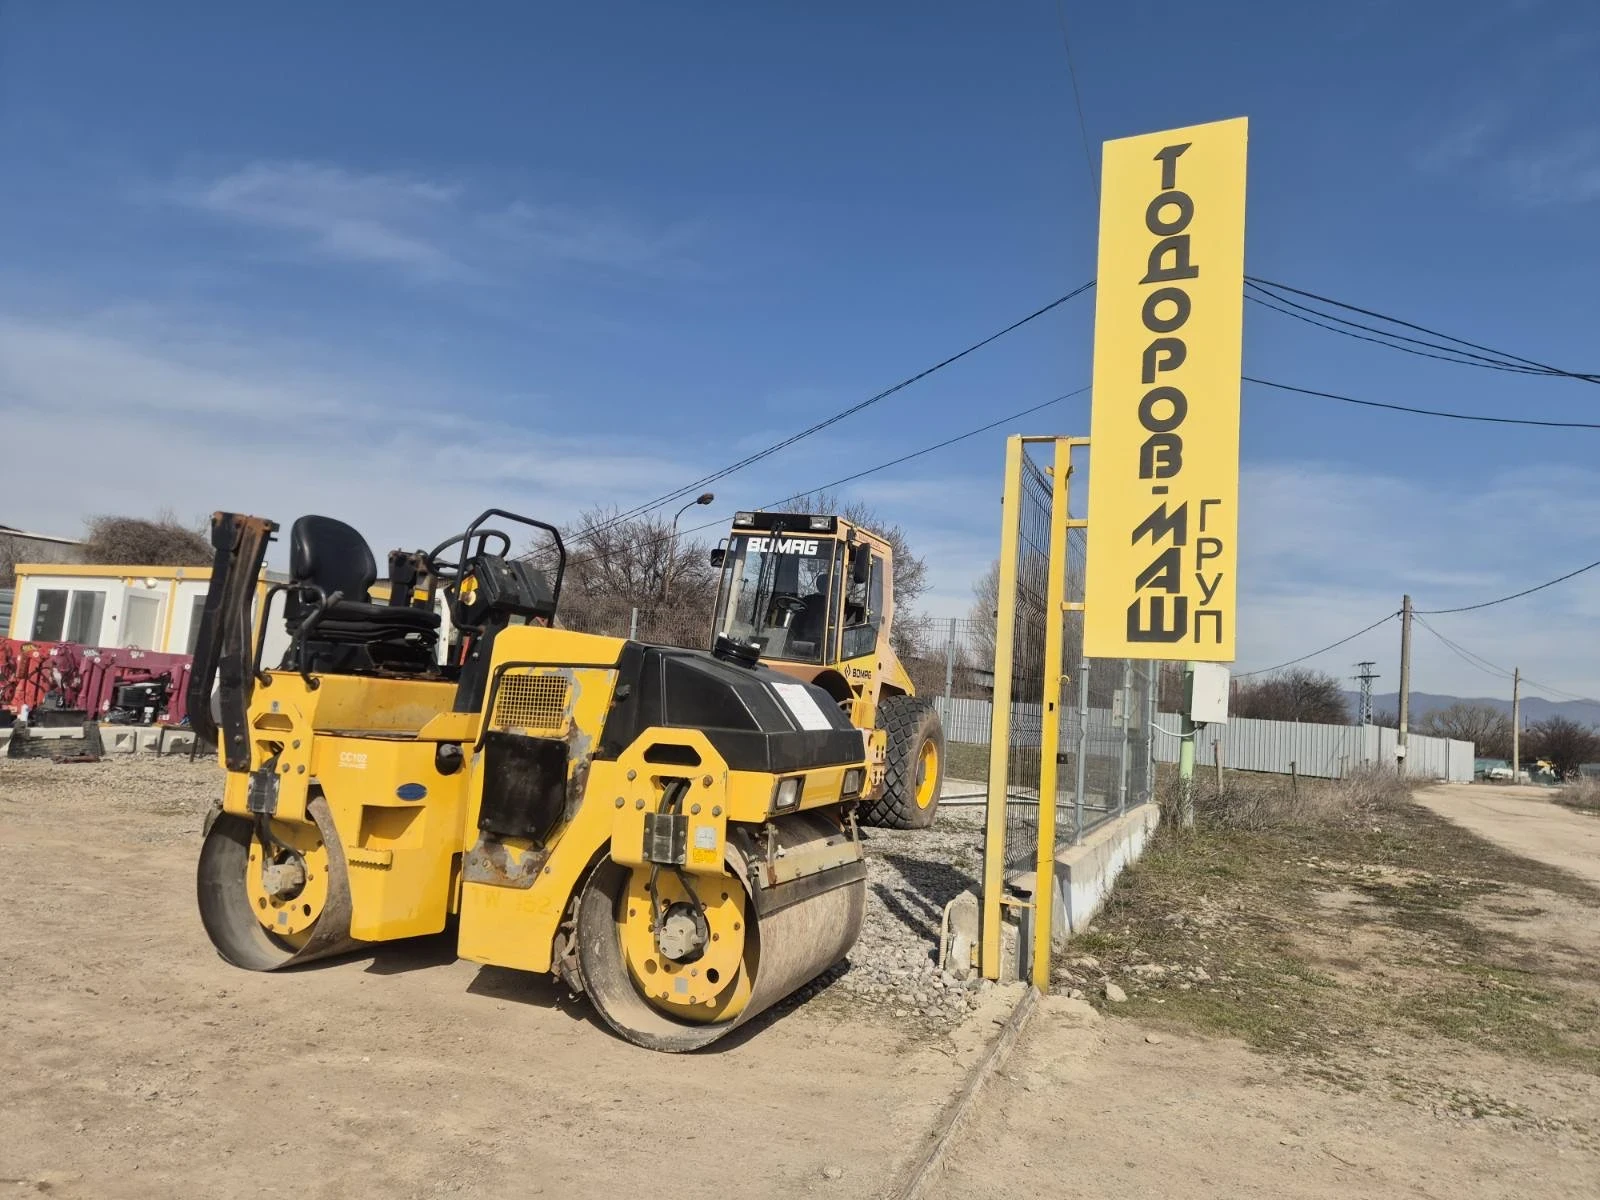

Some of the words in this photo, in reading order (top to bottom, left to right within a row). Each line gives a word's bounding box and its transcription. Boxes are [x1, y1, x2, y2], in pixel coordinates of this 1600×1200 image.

[746, 537, 819, 555] BOMAG
[1194, 499, 1223, 644] ГРУП
[852, 668, 872, 680] BOMAG
